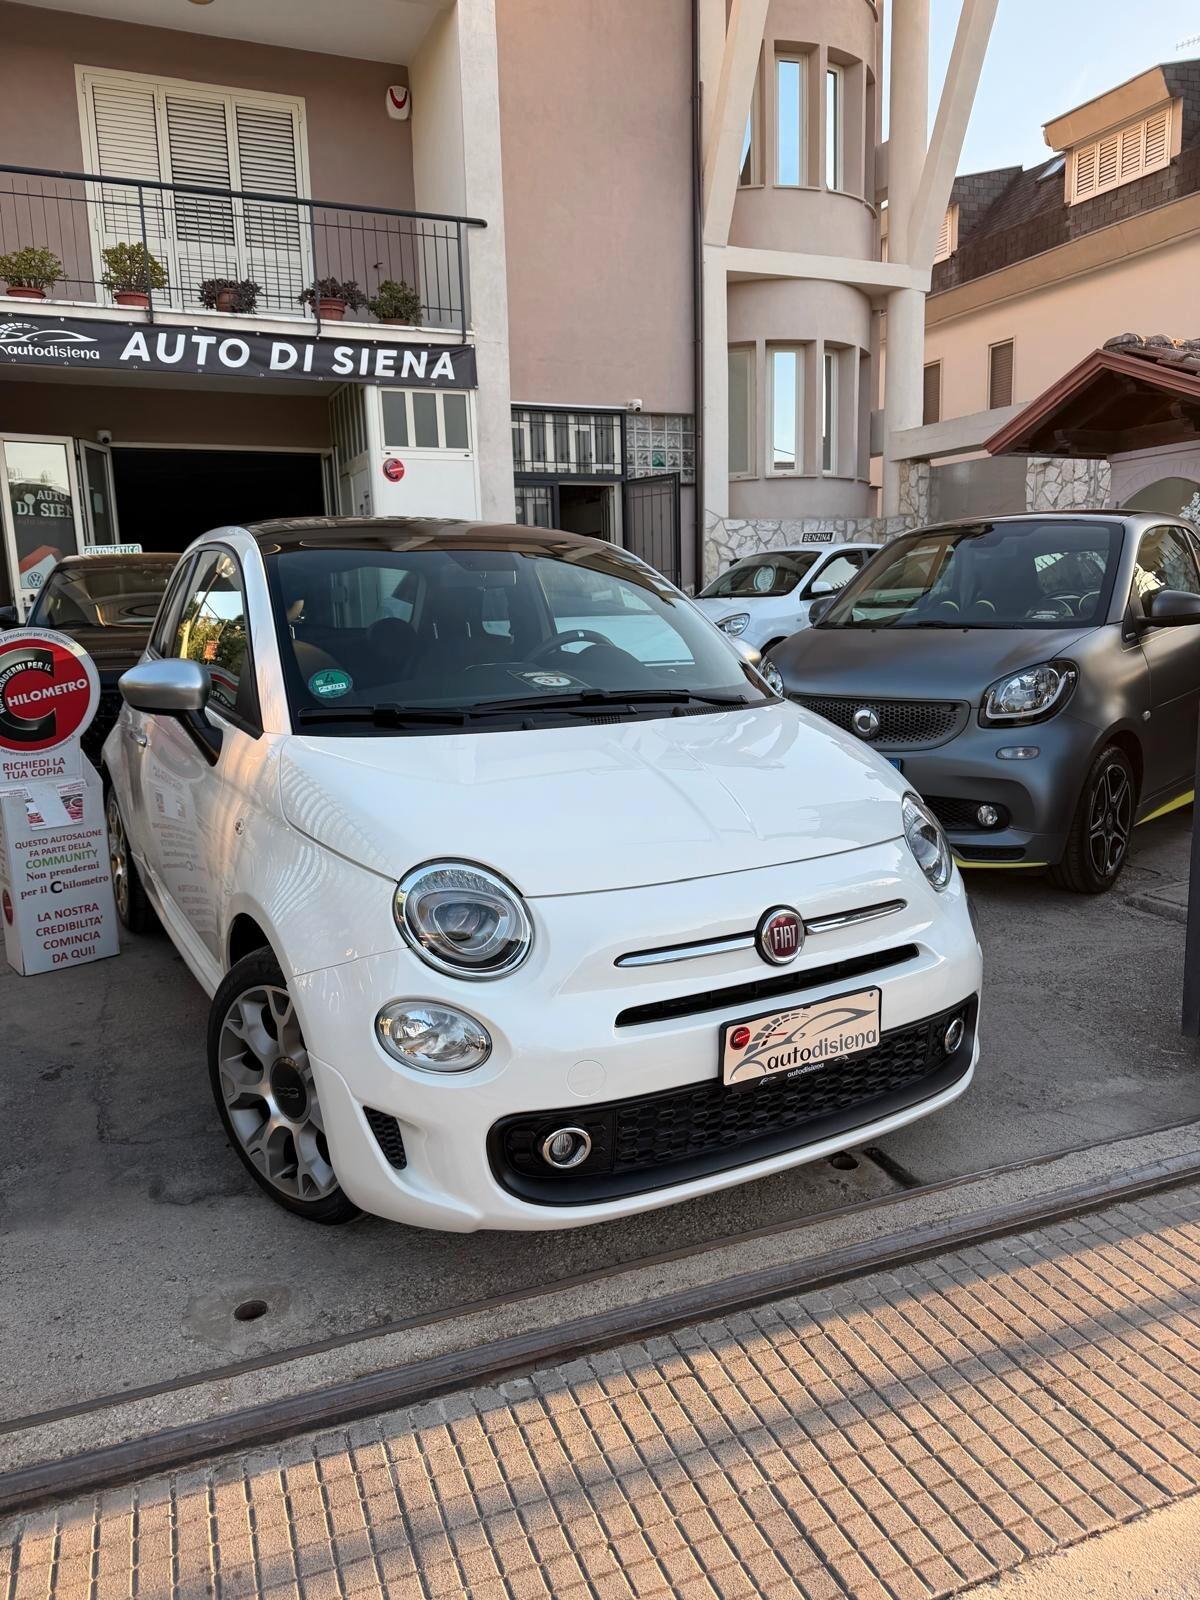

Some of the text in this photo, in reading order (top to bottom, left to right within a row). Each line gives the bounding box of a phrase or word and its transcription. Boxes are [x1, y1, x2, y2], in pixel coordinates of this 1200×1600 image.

[7, 343, 100, 360] autodisiena
[120, 332, 455, 380] AUTO DI SIENA
[37, 490, 66, 502] AUTO
[16, 499, 35, 516] DI
[803, 533, 831, 542] BENZINA
[27, 661, 43, 669] PER
[44, 663, 52, 672] IL
[2, 757, 66, 772] RICHIEDI LA
[5, 766, 64, 780] TUA COPIA
[15, 829, 104, 849] QUESTO AUTOSALONE
[41, 846, 66, 855] PARTE
[68, 842, 92, 851] DELLA
[25, 849, 98, 870] COMMUNITY
[26, 861, 100, 882] Non prendermi
[20, 875, 109, 899] per il Chilometro
[37, 902, 100, 922] LA NOSTRA
[35, 915, 104, 937] CREDIBILITA'
[43, 931, 101, 950] COMINCIA
[773, 924, 798, 950] FIAT
[52, 945, 96, 964] DA QUI!
[767, 1028, 877, 1070] autodisiena
[787, 1062, 825, 1078] autodisiena
